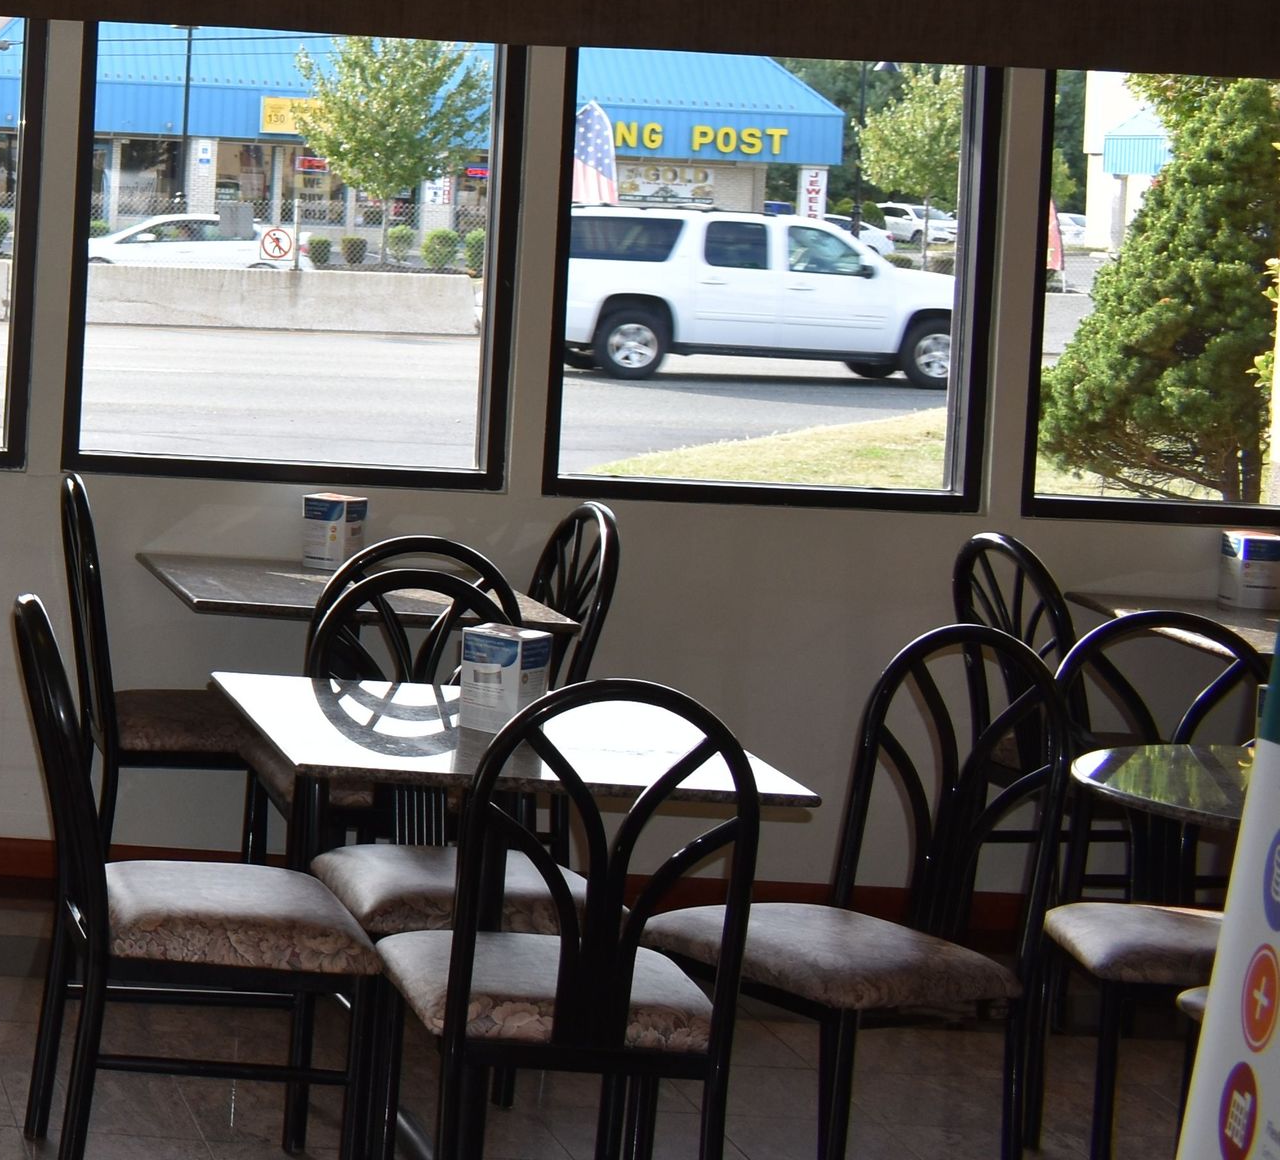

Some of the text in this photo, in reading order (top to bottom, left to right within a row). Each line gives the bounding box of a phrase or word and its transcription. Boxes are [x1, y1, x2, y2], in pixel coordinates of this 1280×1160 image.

[268, 114, 285, 124] 130
[692, 126, 788, 155] POST
[643, 165, 709, 184] GOLD
